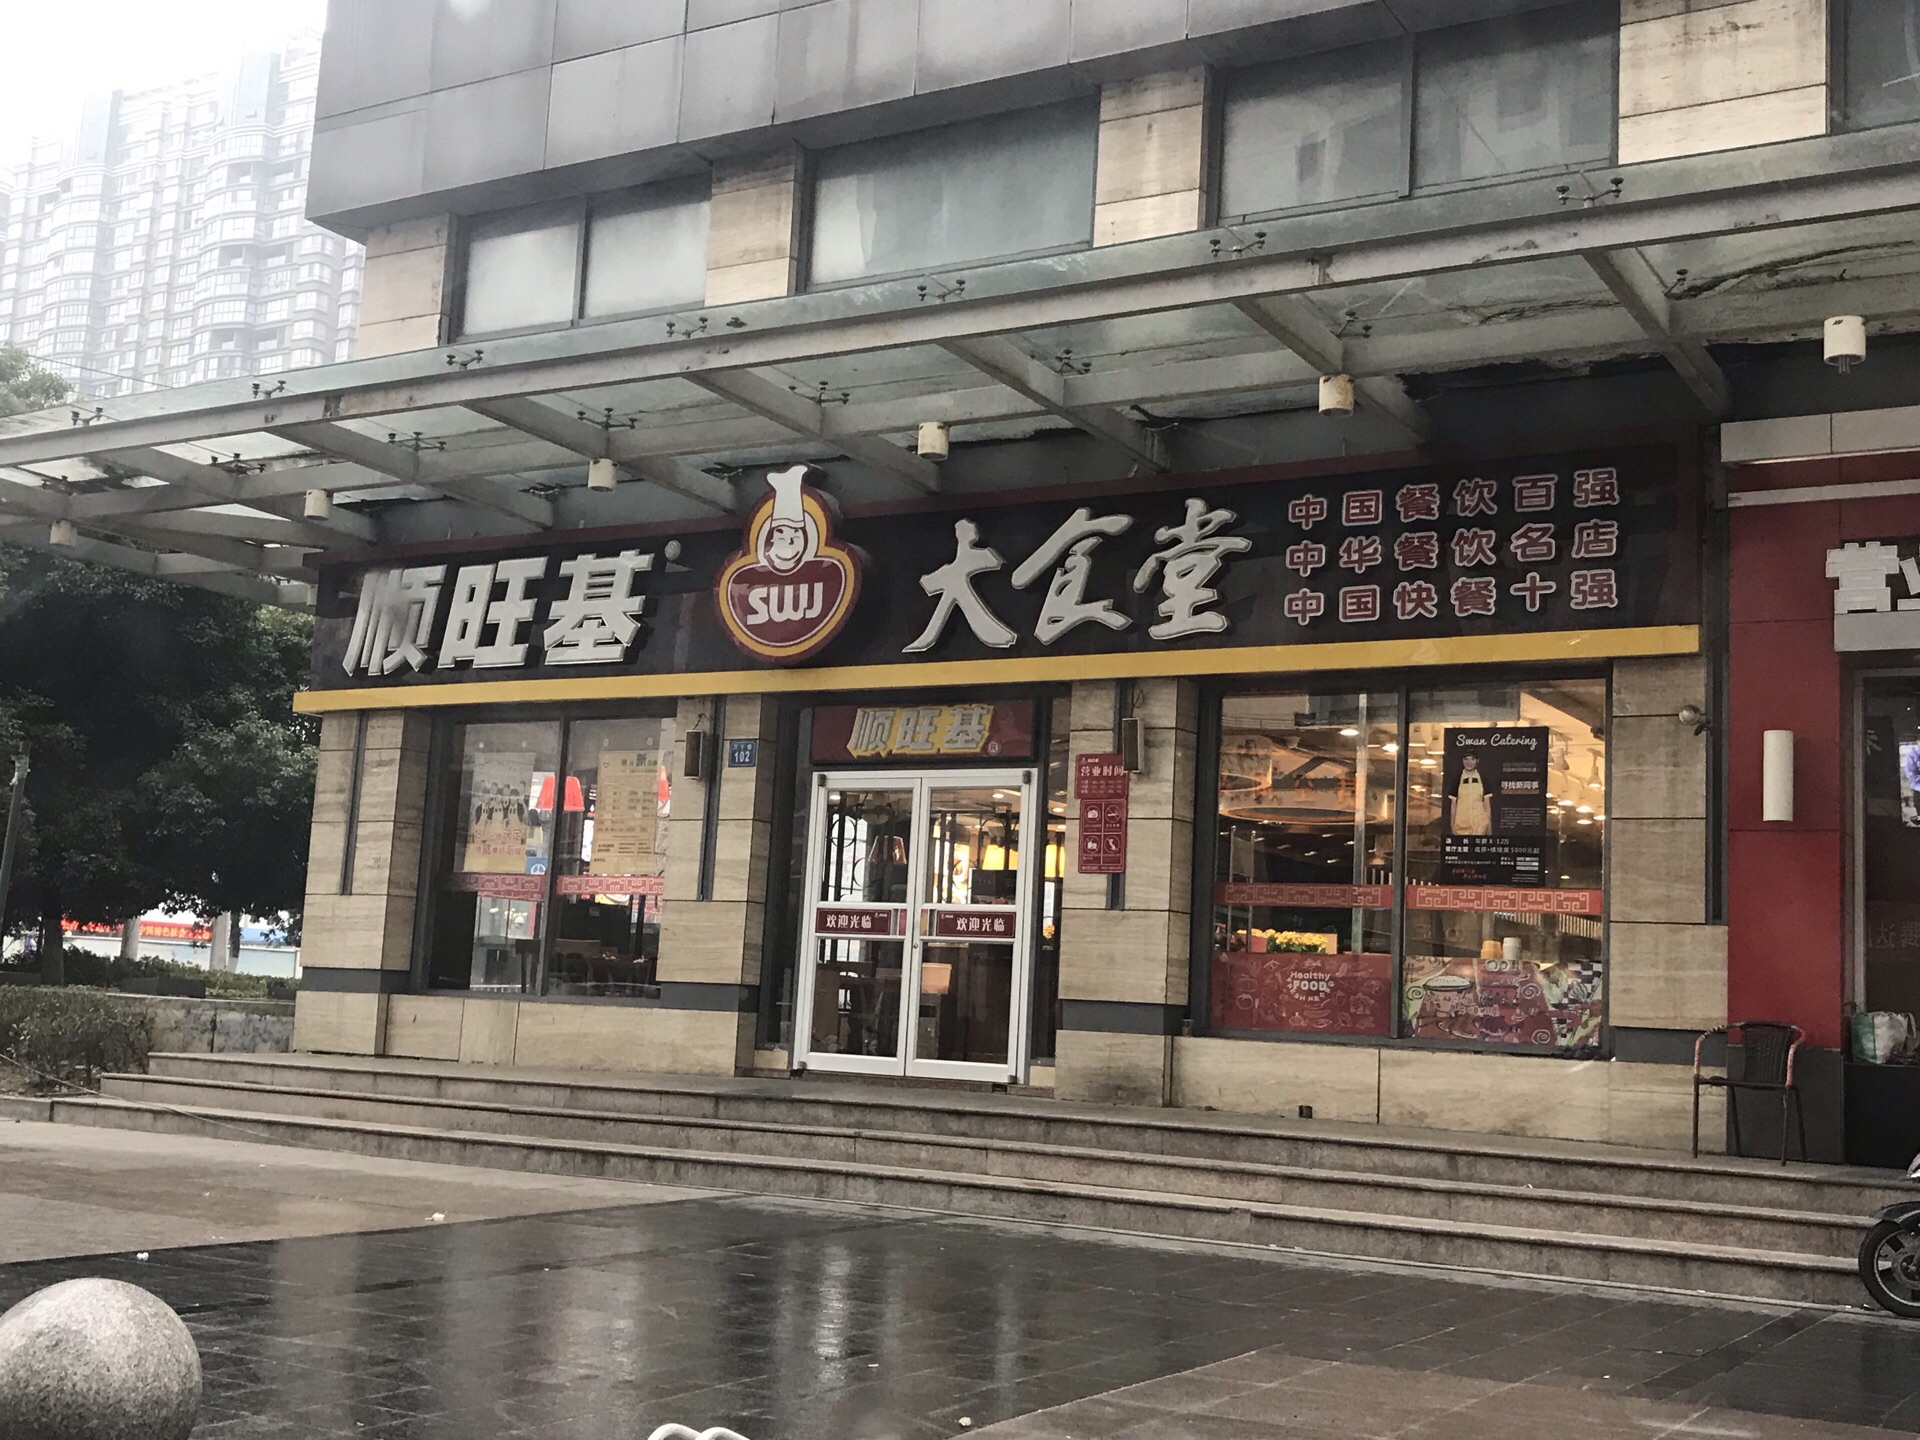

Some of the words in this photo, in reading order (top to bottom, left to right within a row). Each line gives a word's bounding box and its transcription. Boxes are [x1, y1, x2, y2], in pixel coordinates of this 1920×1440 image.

[1288, 467, 1619, 530] 中国餐饮百强
[1286, 519, 1618, 577] 中华餐饮名店
[902, 498, 1252, 652] 大食堂
[747, 582, 823, 625] SWJ
[1284, 568, 1618, 626] 中国快餐十强
[342, 549, 654, 677] 顺旺基
[1456, 733, 1488, 747] Swan
[1490, 733, 1538, 751] Catering
[734, 751, 750, 763] 102
[1081, 765, 1124, 777] 营业时间
[826, 913, 872, 928] 欢迎光临
[956, 916, 1005, 932] 欢迎光临
[1290, 971, 1331, 981] Healthy
[1293, 980, 1328, 991] FOOD
